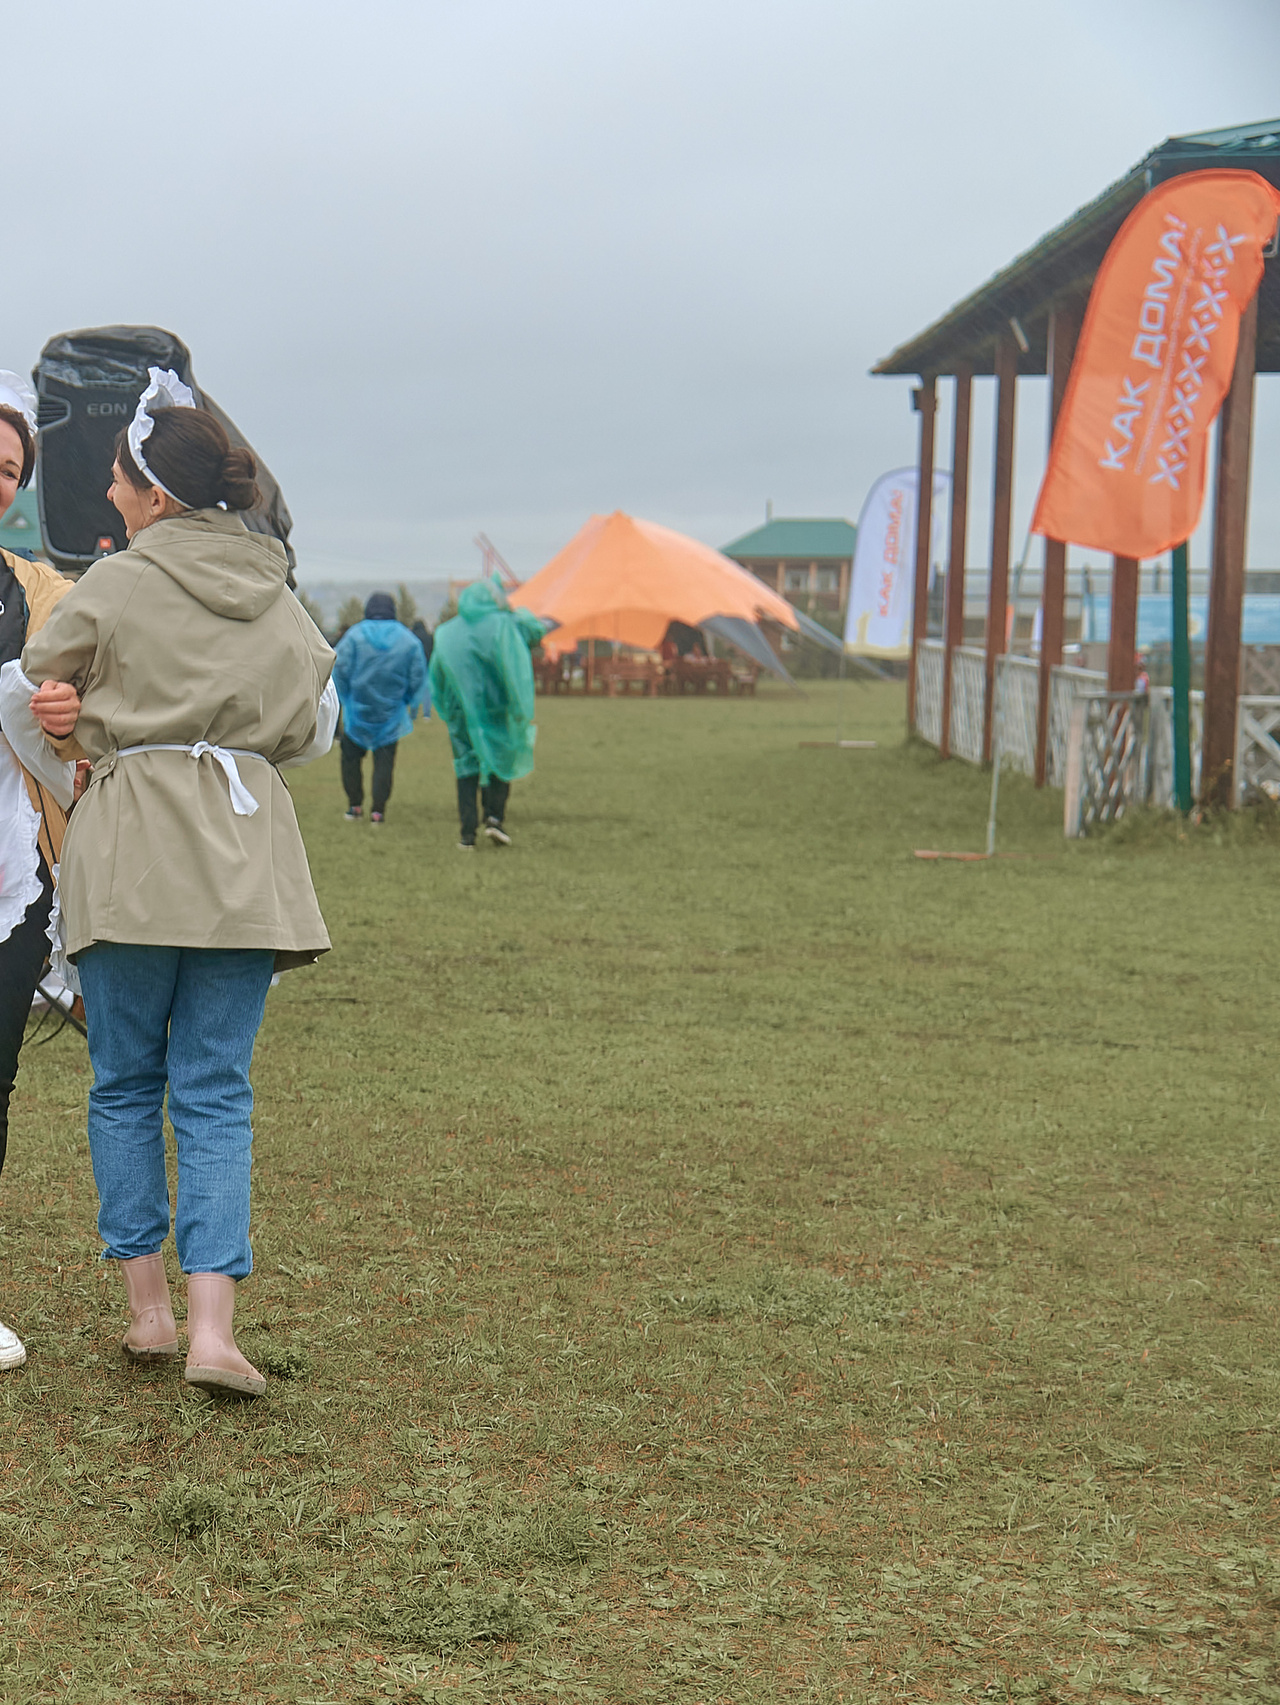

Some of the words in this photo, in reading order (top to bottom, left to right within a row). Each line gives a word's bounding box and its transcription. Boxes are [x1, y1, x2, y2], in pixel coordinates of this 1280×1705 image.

[86, 402, 128, 416] EON
[1099, 376, 1151, 470] КАК
[1130, 212, 1188, 368] ДОМА!
